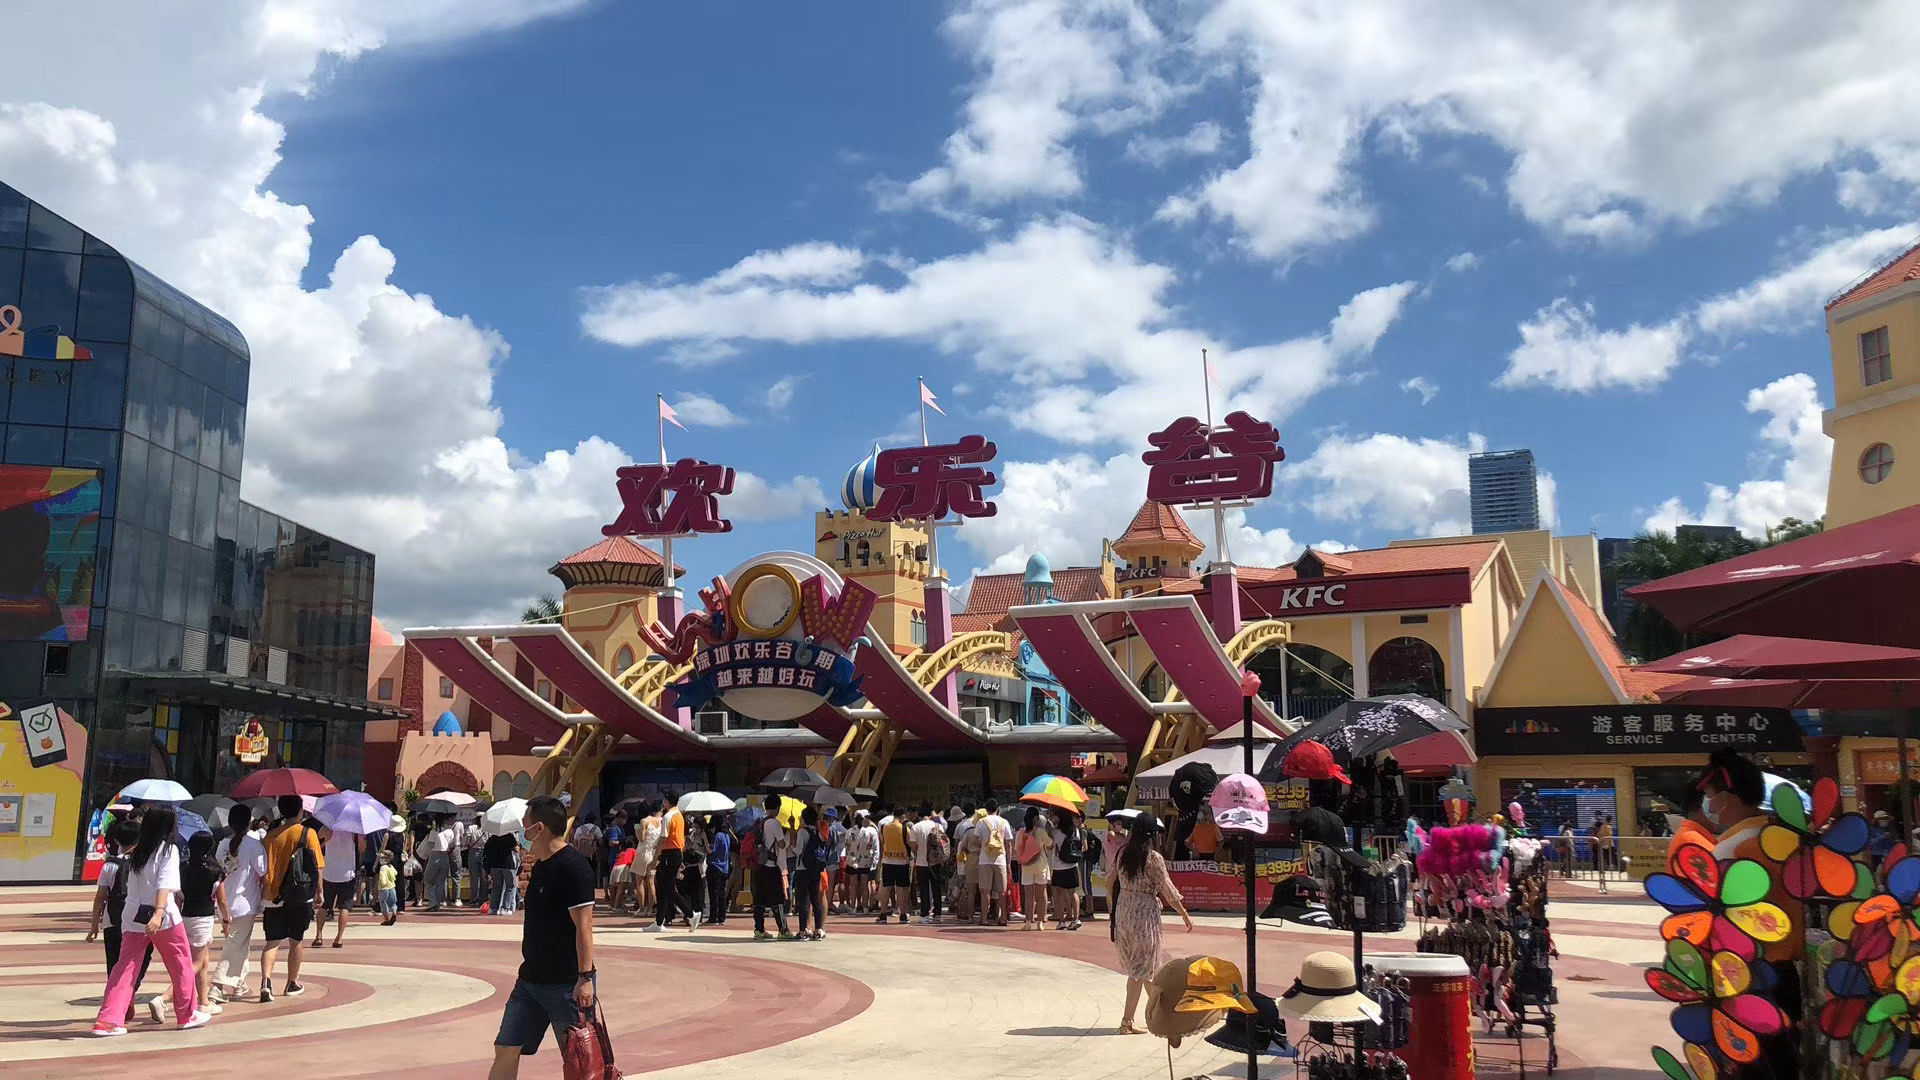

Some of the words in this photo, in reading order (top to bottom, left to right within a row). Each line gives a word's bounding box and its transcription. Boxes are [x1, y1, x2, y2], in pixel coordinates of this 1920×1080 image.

[843, 530, 865, 540] Pizza
[866, 527, 886, 538] Hut
[1128, 568, 1157, 579] KFC
[1279, 584, 1346, 609] KFC
[716, 666, 816, 688] 越来越好玩
[1593, 713, 1769, 733] 游客服务中心
[1607, 734, 1663, 744] SERVICE
[1700, 733, 1757, 744] CENTER
